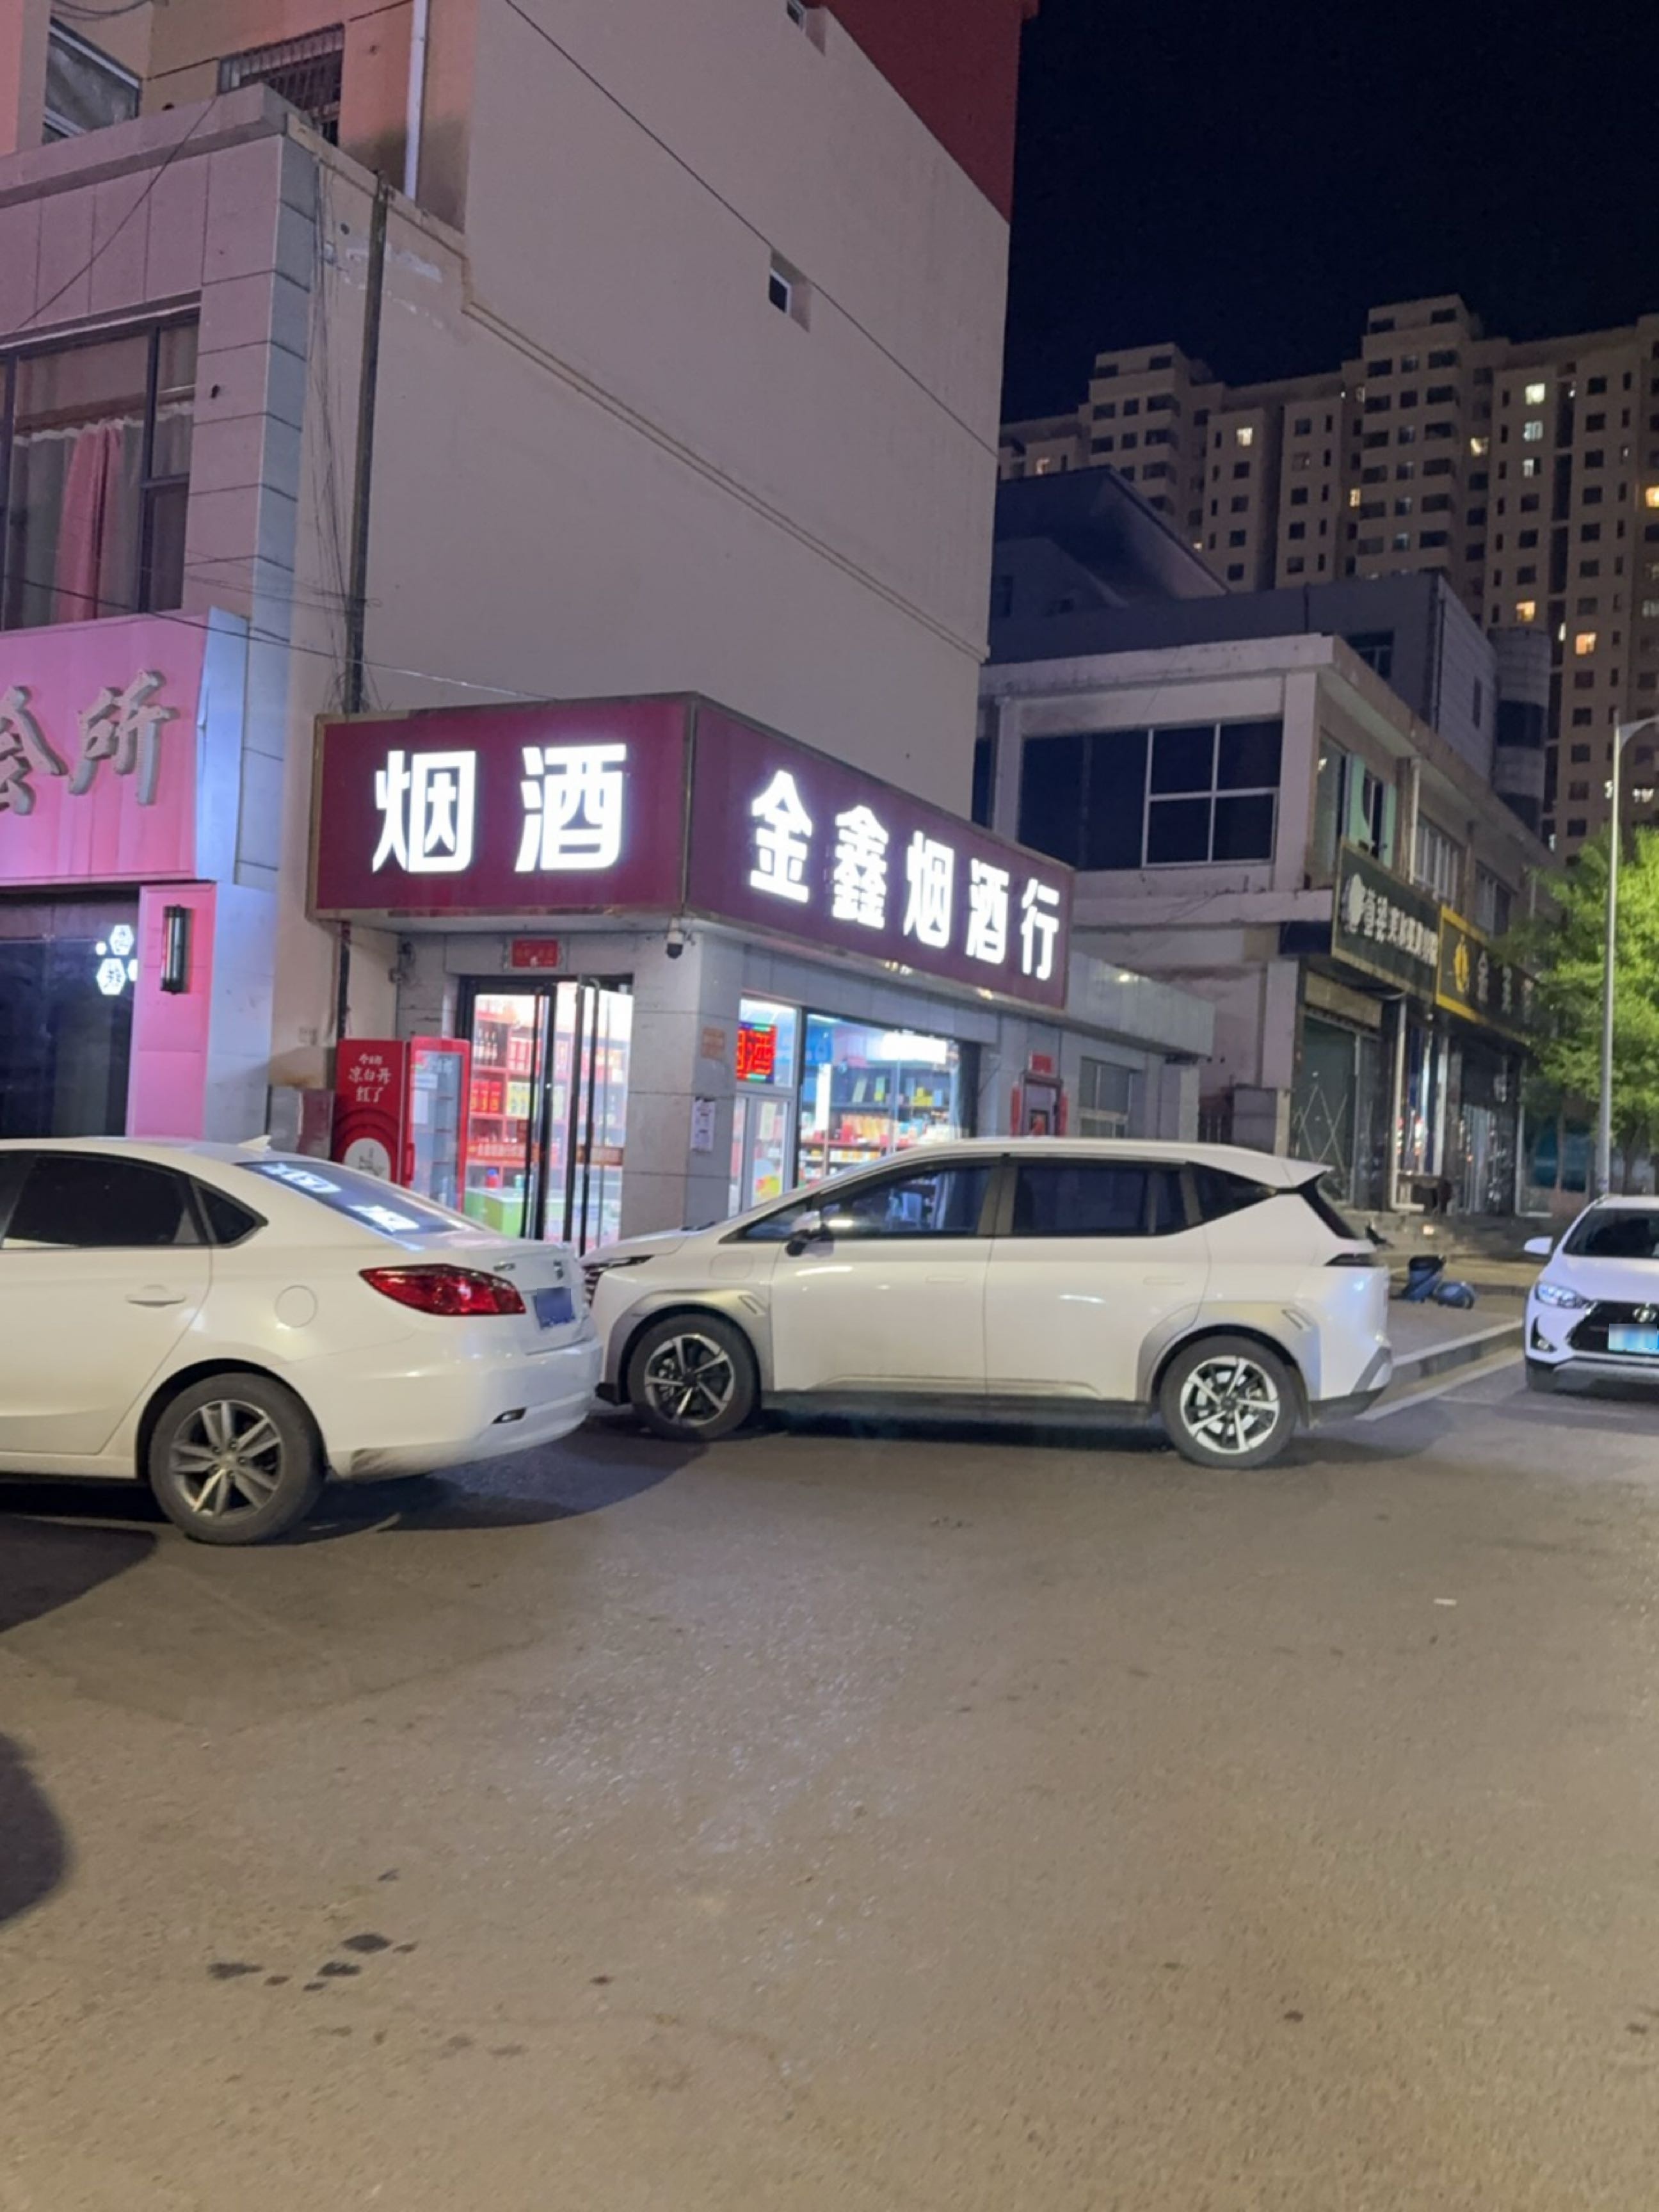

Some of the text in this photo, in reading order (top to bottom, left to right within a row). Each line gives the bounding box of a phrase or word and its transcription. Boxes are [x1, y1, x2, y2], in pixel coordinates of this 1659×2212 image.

[372, 743, 627, 872] 烟酒
[749, 769, 1059, 981] 金鑫烟酒行
